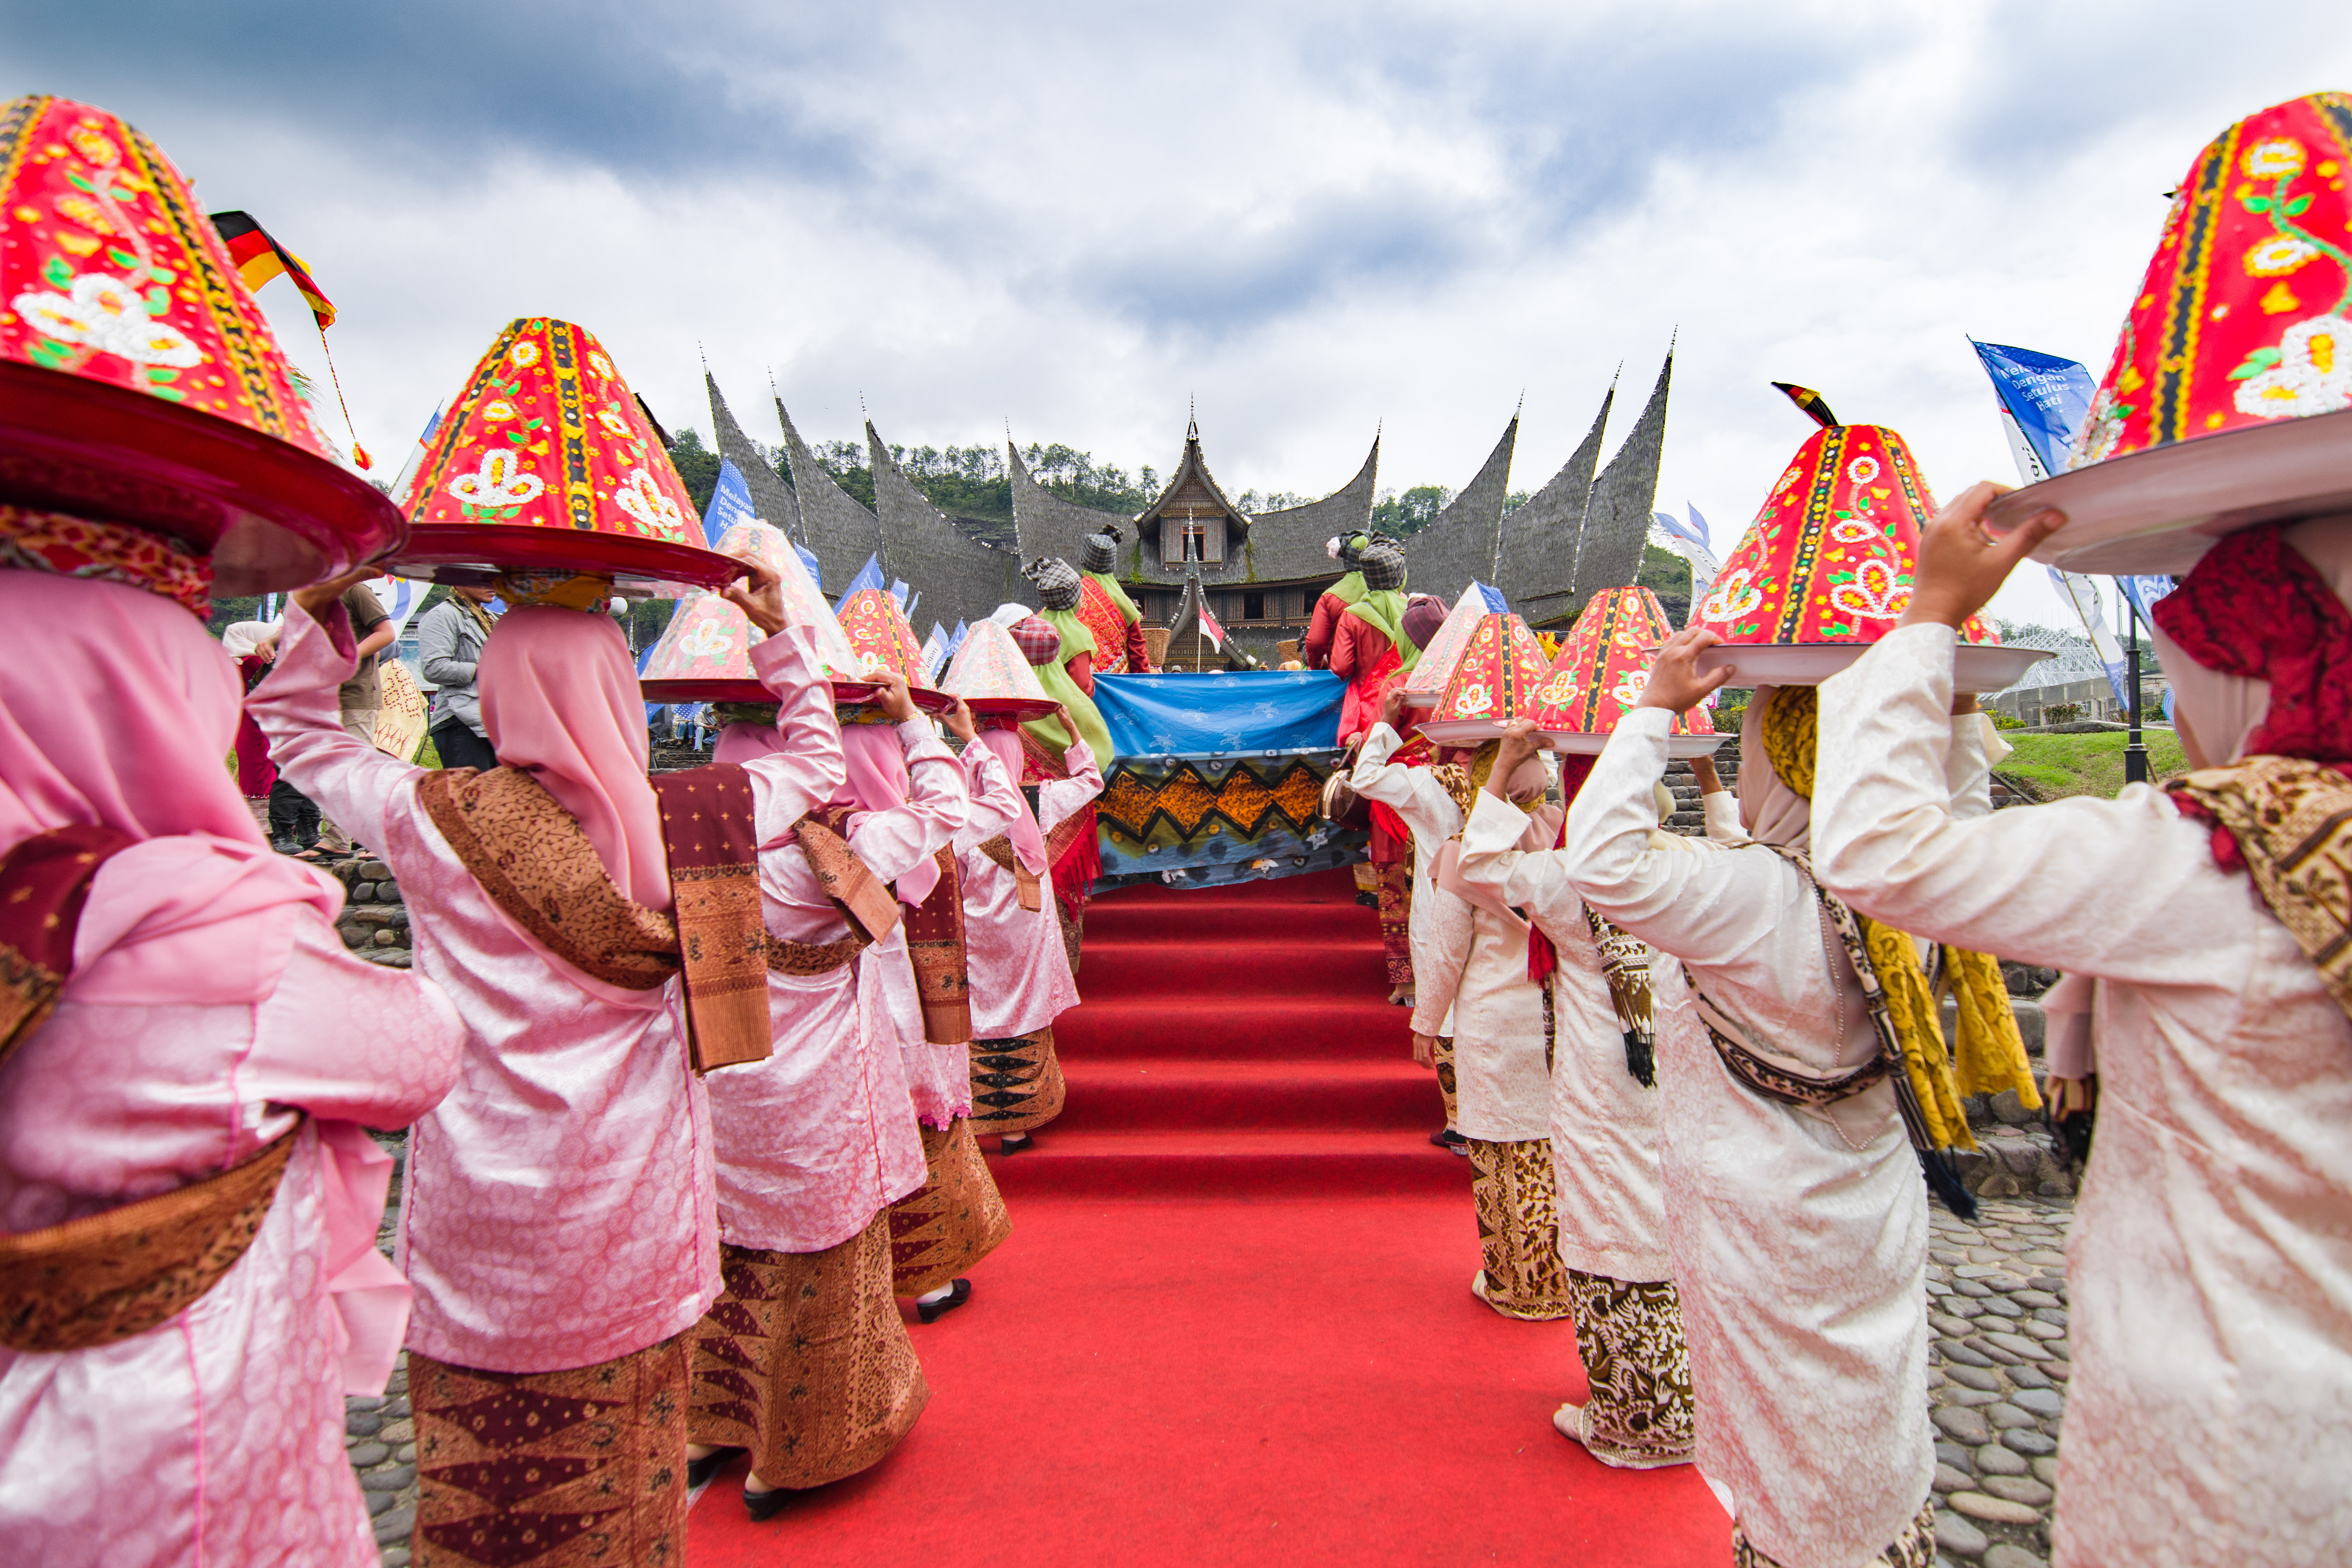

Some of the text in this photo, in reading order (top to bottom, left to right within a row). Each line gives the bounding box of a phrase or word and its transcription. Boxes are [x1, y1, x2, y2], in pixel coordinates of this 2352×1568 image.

[2011, 375, 2066, 390] Dengan
[2021, 383, 2070, 402] Setulus
[2035, 394, 2062, 412] Hati
[720, 484, 755, 514] Melayani
